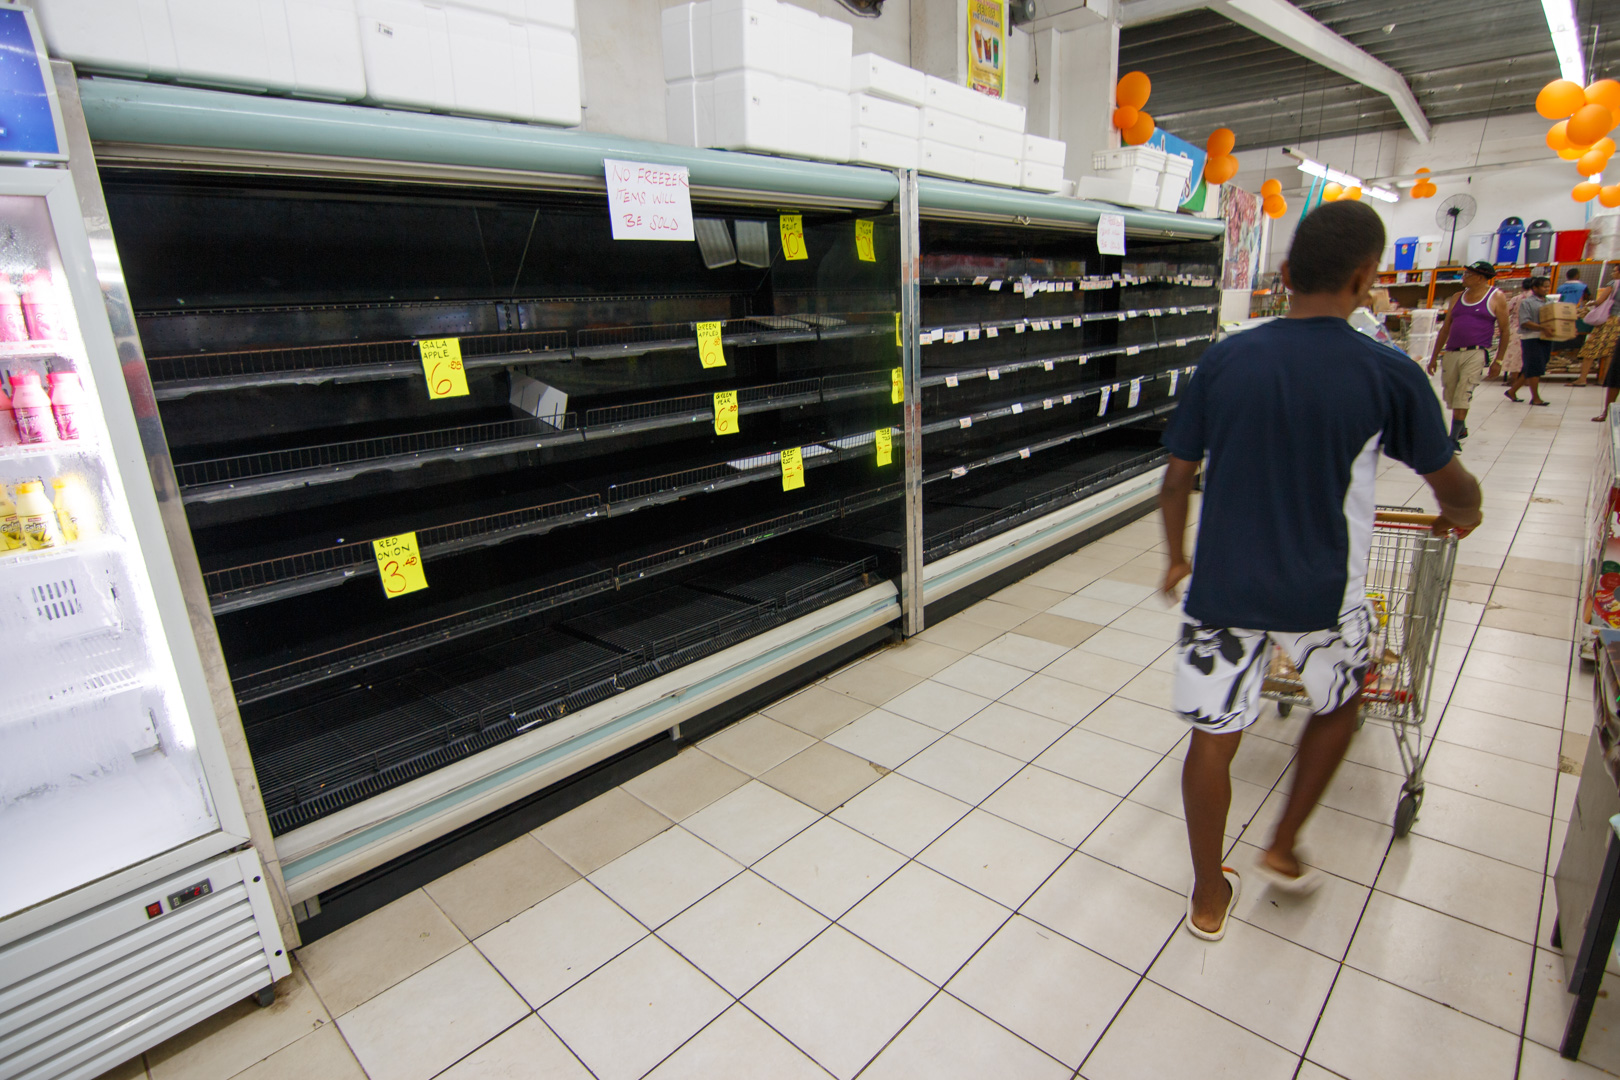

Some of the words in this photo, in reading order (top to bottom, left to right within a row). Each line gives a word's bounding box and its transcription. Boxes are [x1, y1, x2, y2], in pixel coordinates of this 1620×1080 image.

[612, 165, 631, 183] NO
[637, 168, 689, 188] FREEZER
[615, 188, 646, 206] ITEMS
[652, 192, 676, 205] WILL
[622, 213, 643, 228] BE
[649, 214, 679, 231] SOLD
[697, 323, 717, 331] GREEN
[422, 340, 448, 349] GALA
[423, 349, 450, 360] APPLE
[378, 537, 398, 549] RED
[377, 543, 411, 561] ONION
